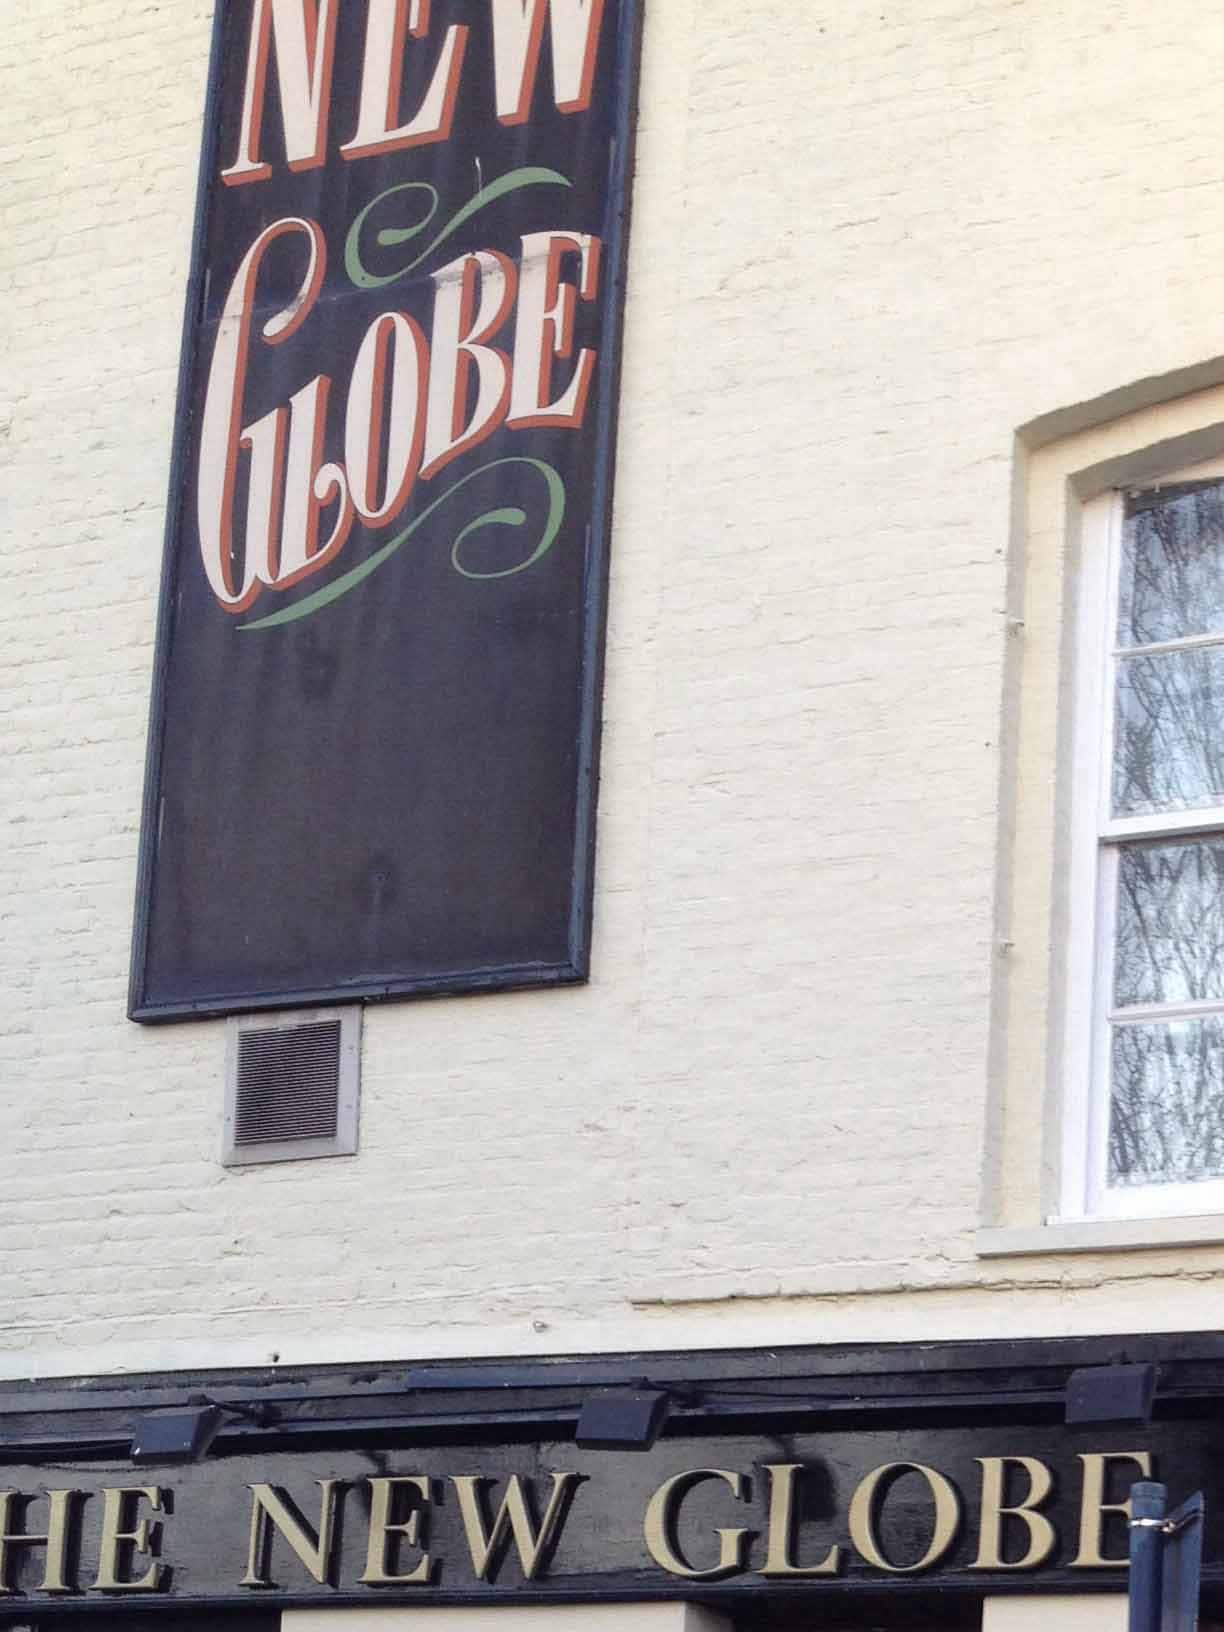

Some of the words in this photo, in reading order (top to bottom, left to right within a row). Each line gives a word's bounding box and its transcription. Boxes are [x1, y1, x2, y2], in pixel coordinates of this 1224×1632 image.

[198, 216, 601, 615] GLOBE
[240, 1473, 585, 1588] NEW
[643, 1451, 1153, 1579] GLOBE
